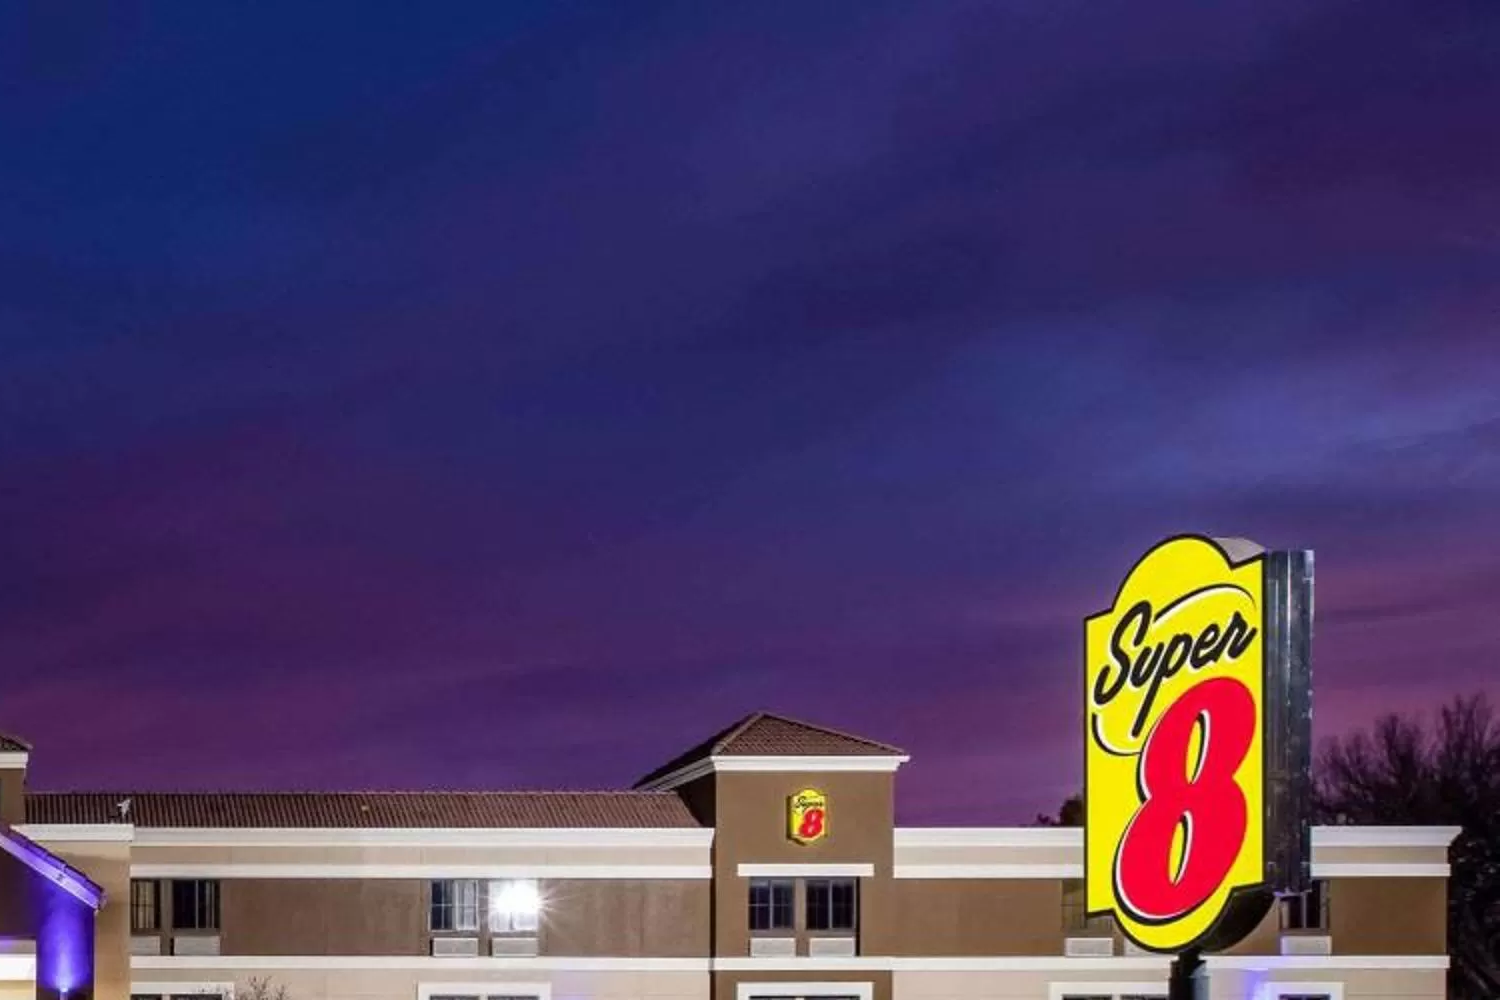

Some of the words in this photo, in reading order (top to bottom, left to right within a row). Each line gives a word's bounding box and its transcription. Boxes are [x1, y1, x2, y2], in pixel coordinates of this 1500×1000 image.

[1093, 599, 1257, 739] Super
[799, 808, 825, 839] 8
[1113, 676, 1257, 925] 8
